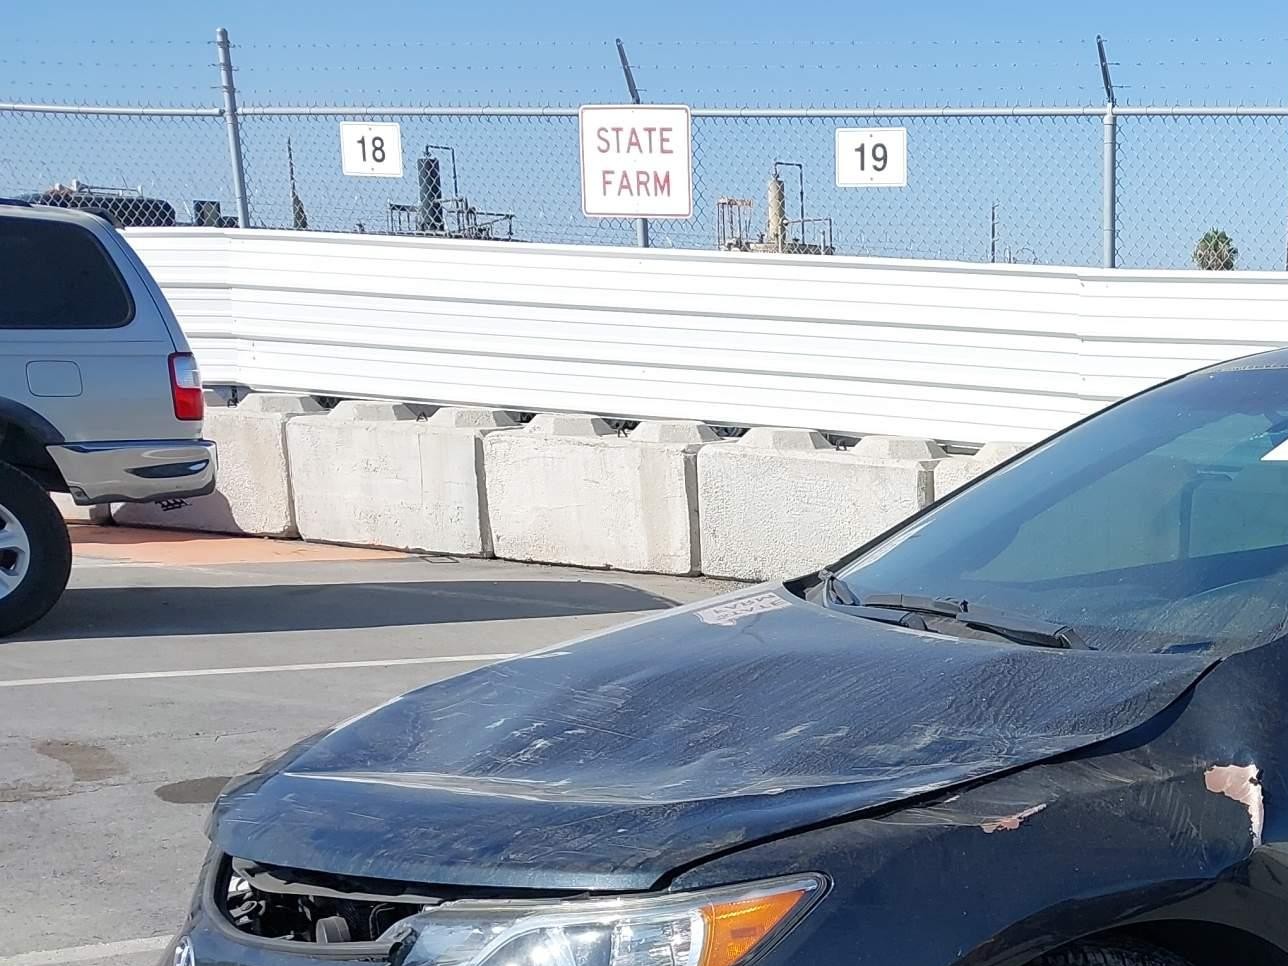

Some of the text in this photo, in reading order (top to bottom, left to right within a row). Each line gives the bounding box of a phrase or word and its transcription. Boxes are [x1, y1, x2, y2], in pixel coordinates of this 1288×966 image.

[356, 135, 386, 163] 18
[596, 126, 674, 155] STATE
[854, 142, 888, 172] 19
[601, 169, 671, 197] FARM
